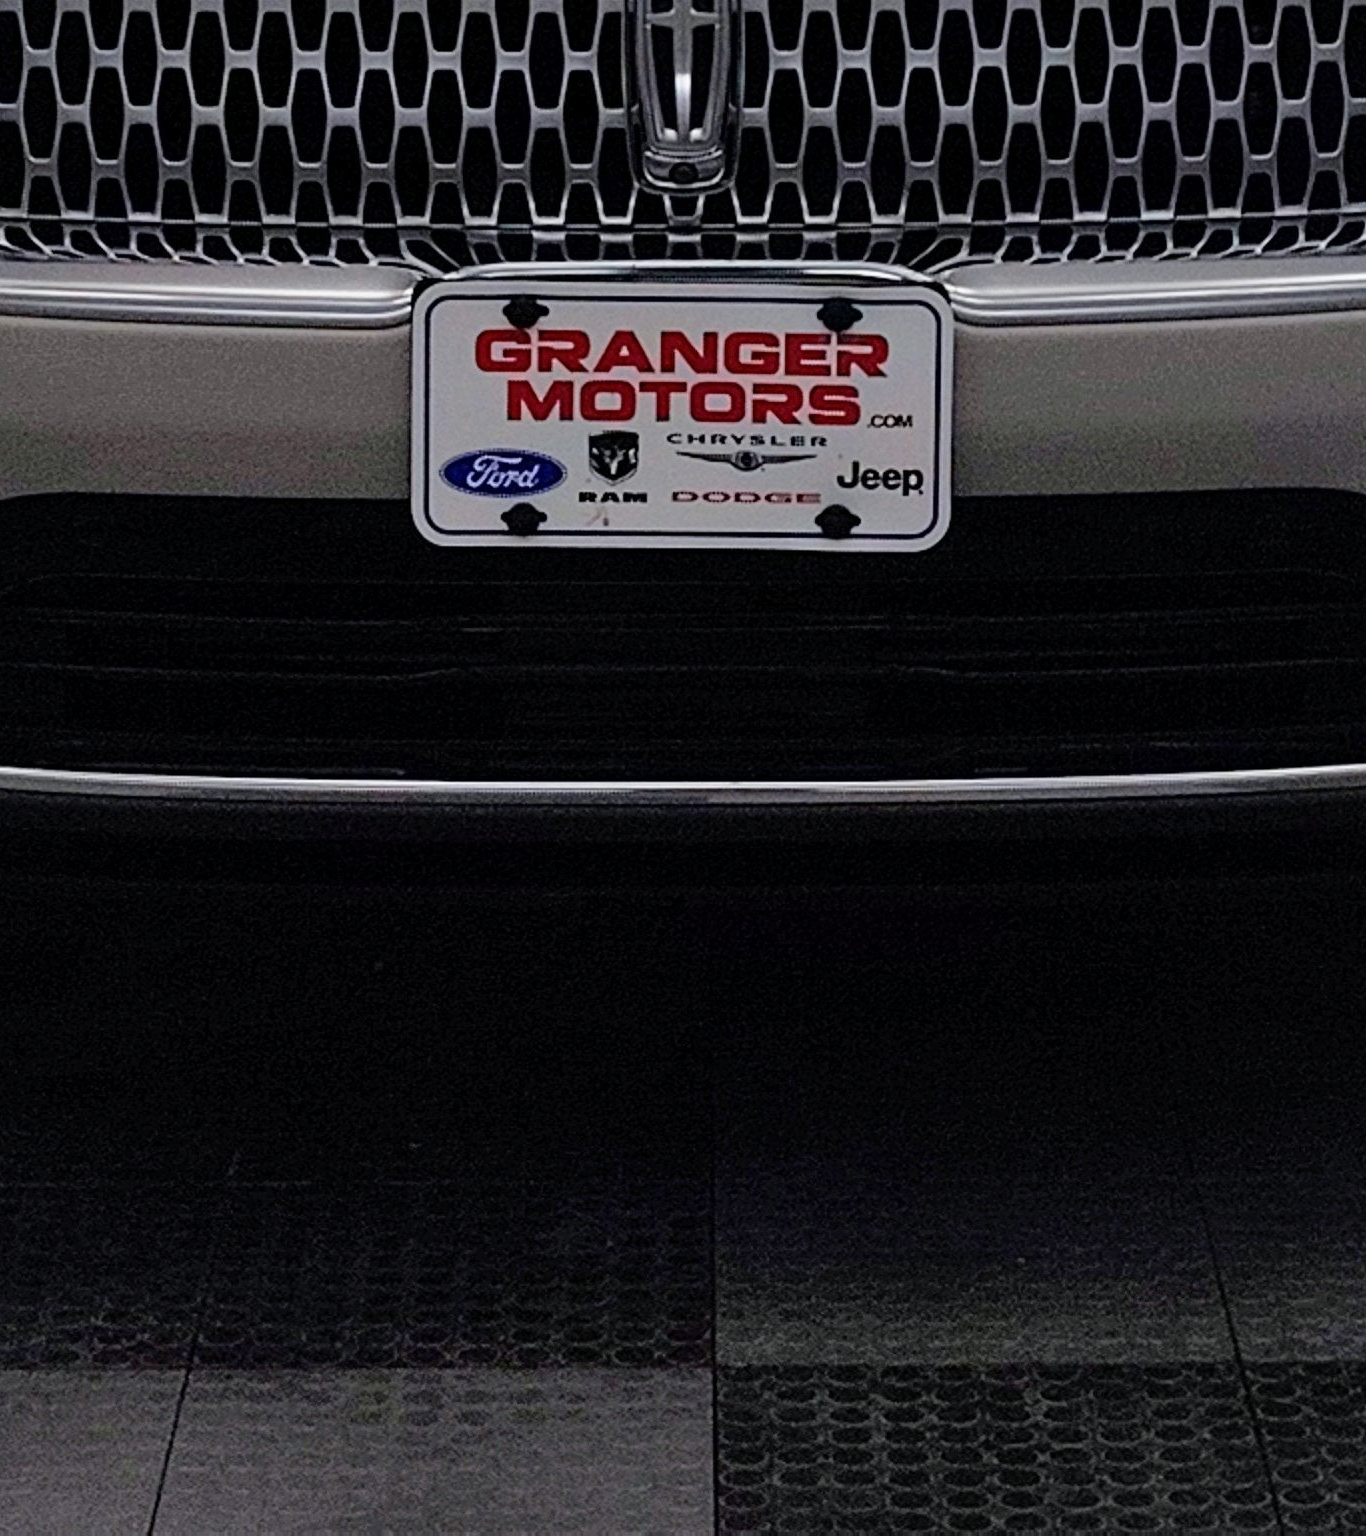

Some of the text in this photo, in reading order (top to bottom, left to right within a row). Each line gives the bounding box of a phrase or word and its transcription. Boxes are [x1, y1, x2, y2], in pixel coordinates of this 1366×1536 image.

[475, 329, 889, 378] GRANGER
[506, 380, 861, 426] MOTORS
[666, 433, 828, 447] CHRYSLER
[466, 455, 539, 489] Ford
[836, 461, 924, 496] Jeep
[578, 492, 648, 504] RAM
[671, 492, 822, 504] DODGE
